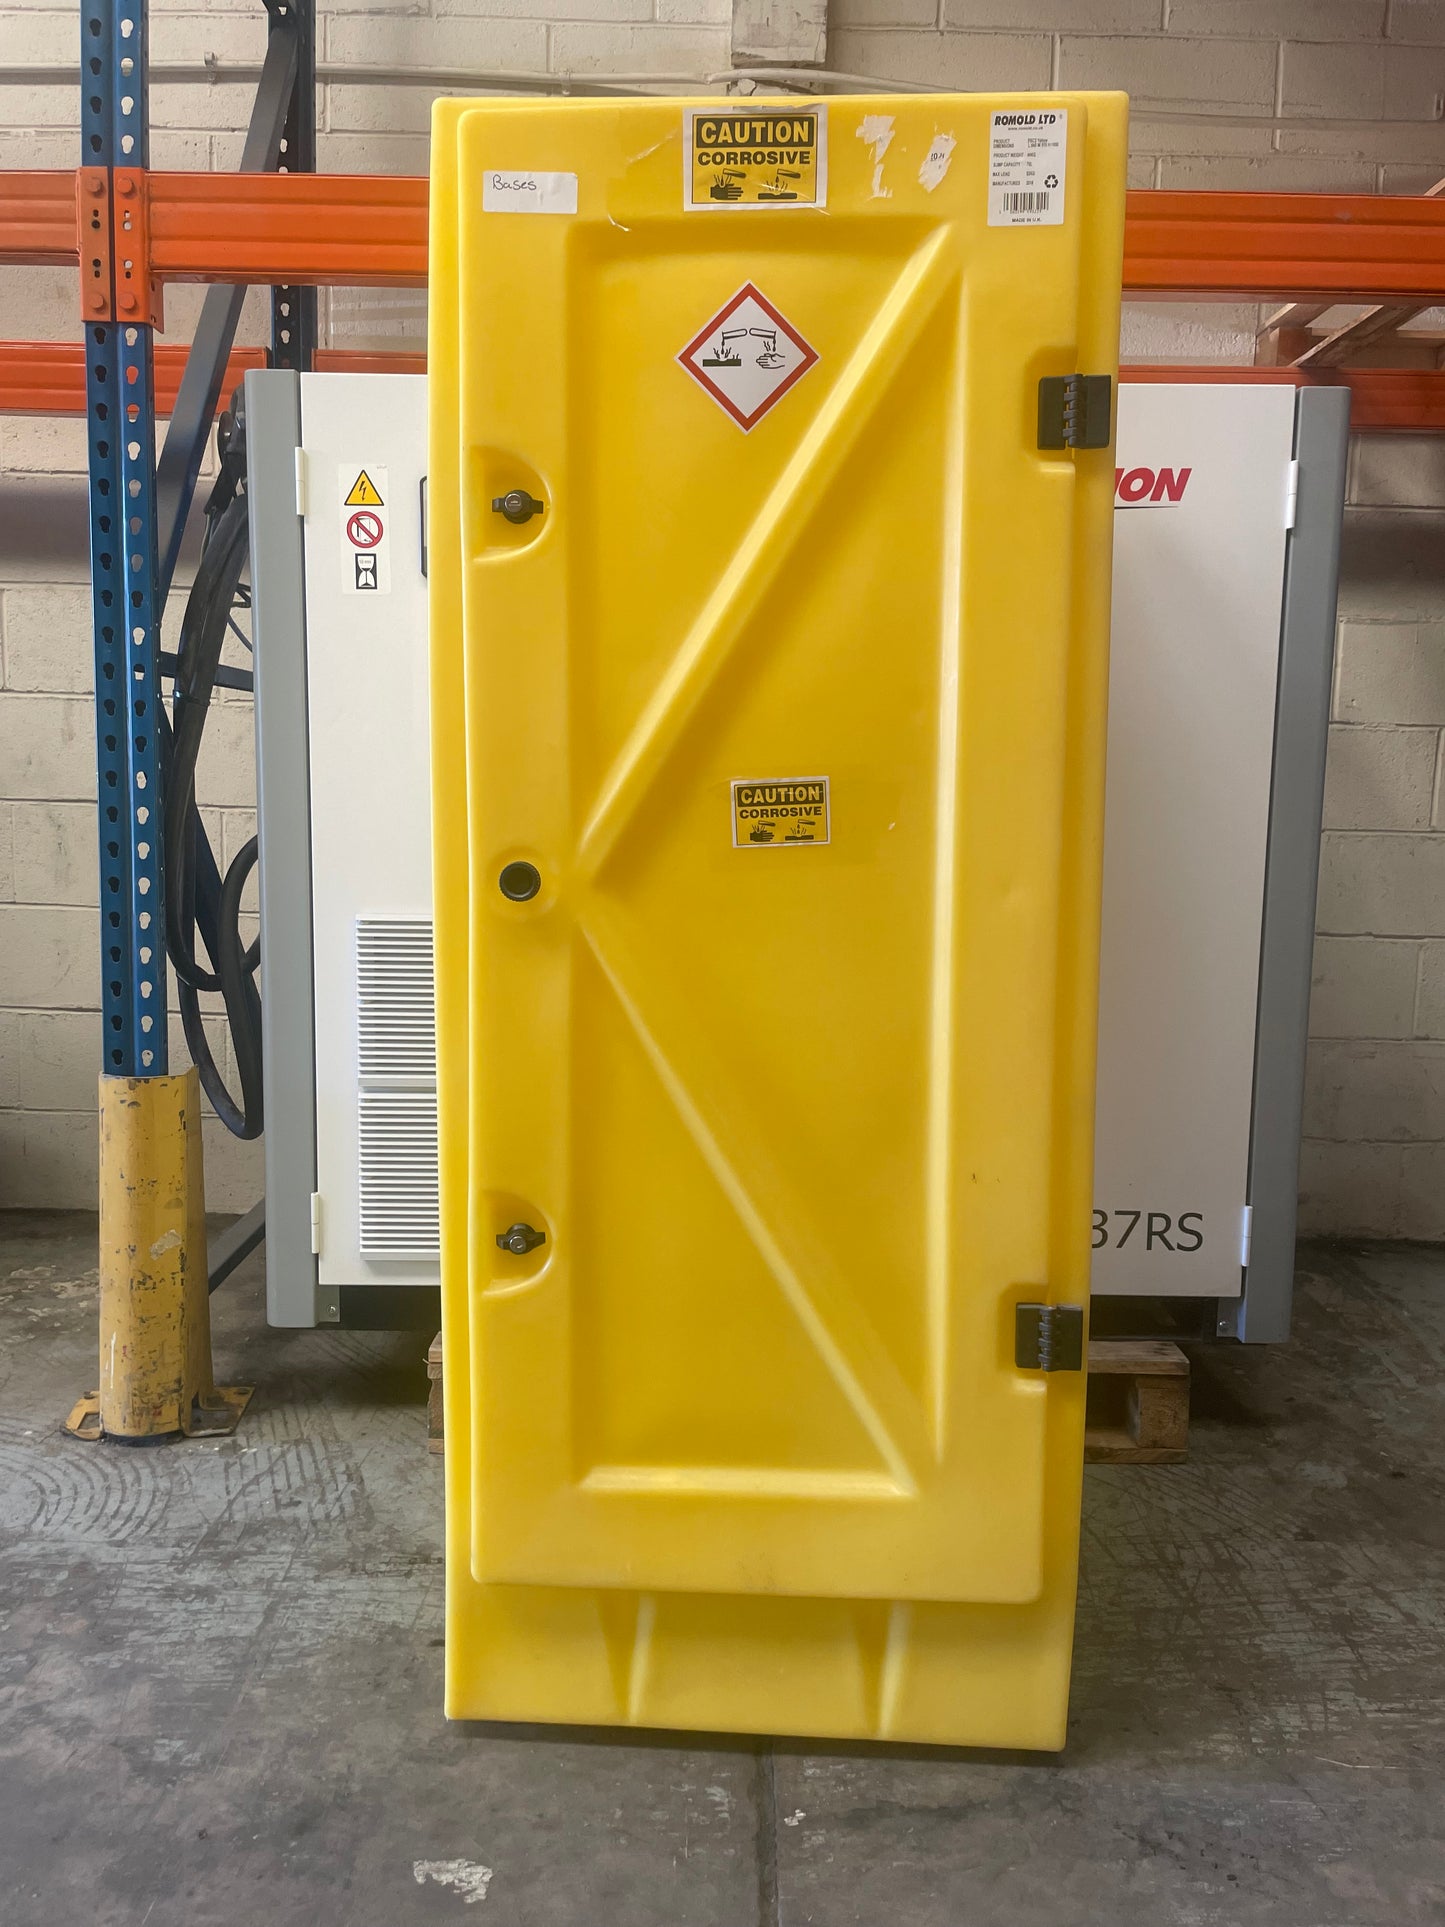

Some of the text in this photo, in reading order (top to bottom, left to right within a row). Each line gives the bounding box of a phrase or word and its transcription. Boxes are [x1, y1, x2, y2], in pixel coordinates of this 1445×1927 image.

[994, 114, 1056, 126] ROMOLD LTD
[701, 121, 809, 144] CAUTION
[698, 151, 811, 166] CORROSIVE
[492, 174, 537, 191] Bases
[740, 786, 820, 804] CAUTION
[739, 806, 822, 819] CORROSIVE
